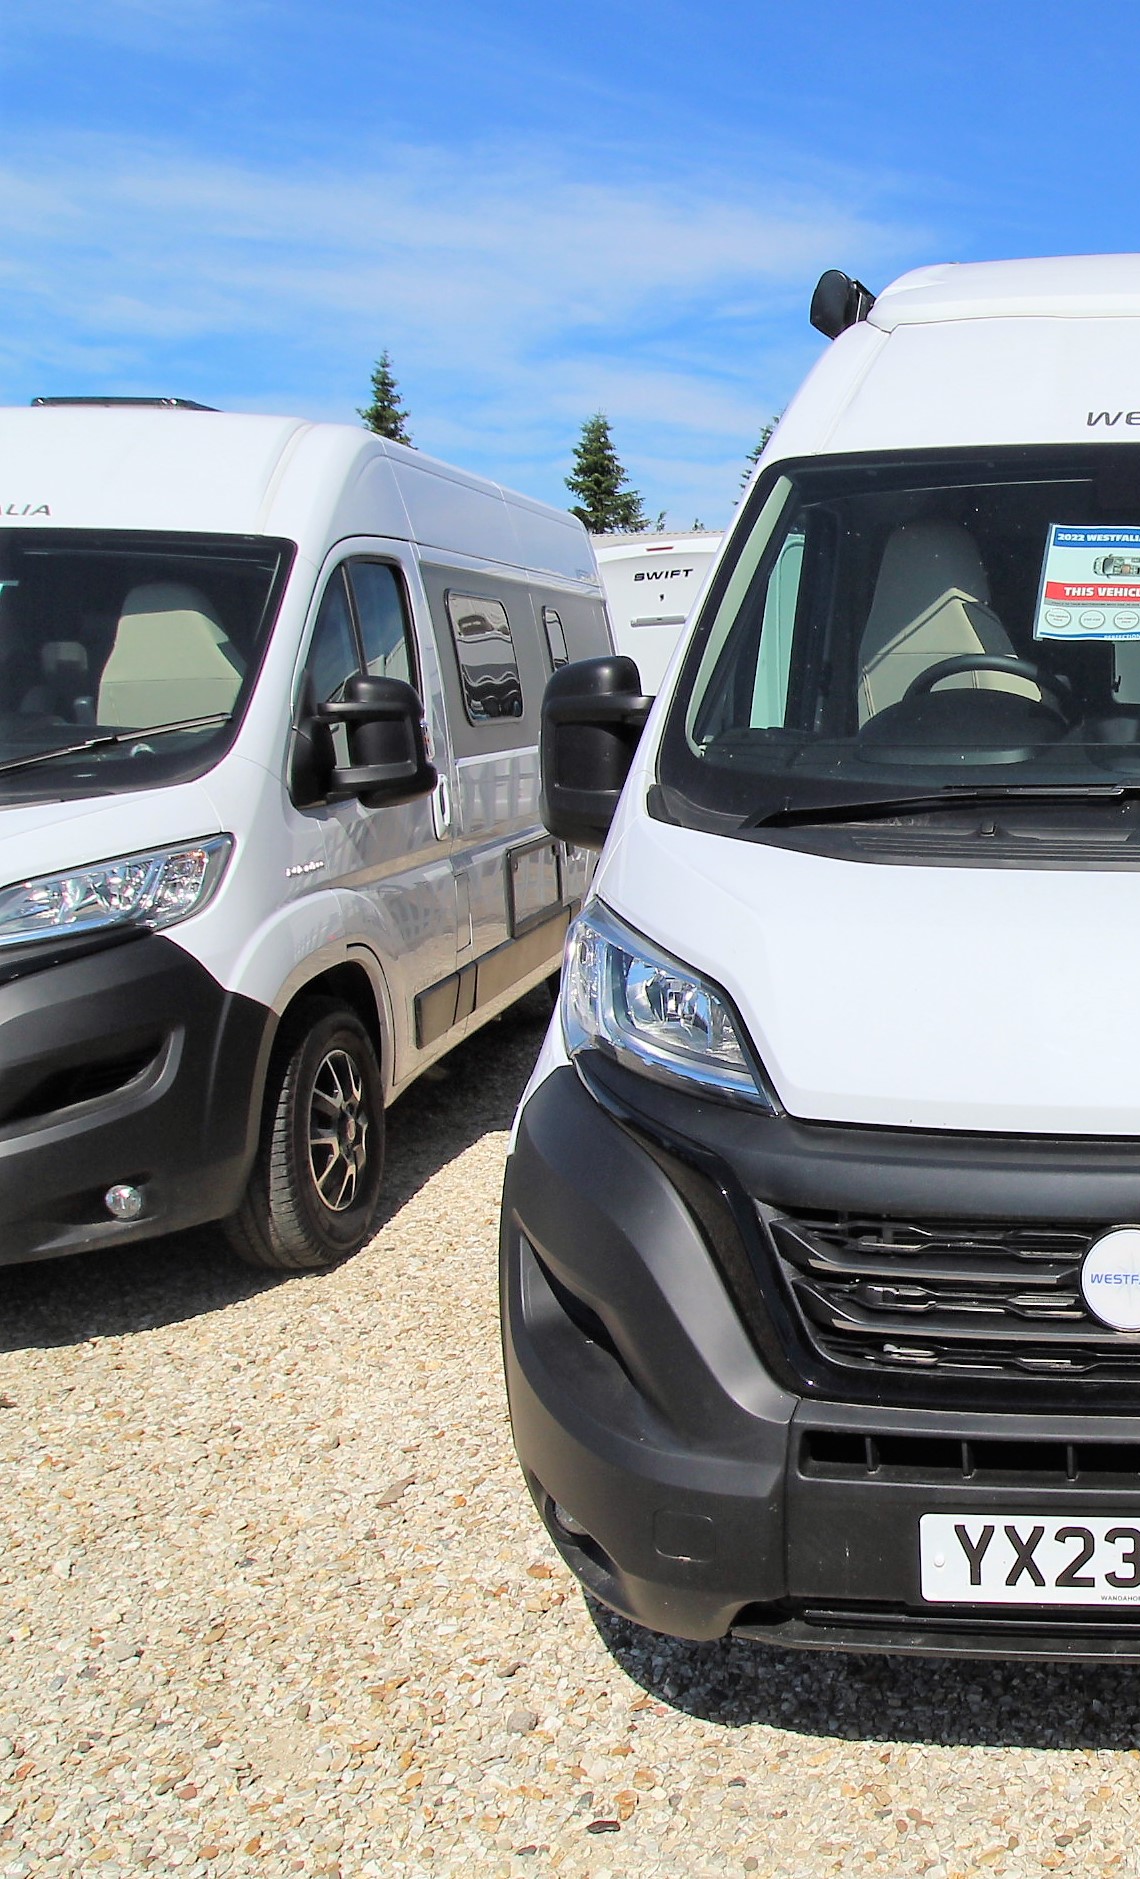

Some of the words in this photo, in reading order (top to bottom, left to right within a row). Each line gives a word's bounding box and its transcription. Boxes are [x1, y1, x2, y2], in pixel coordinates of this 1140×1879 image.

[1057, 533, 1085, 542] 2022
[634, 568, 694, 582] SWIFT
[1064, 586, 1094, 596] THIS
